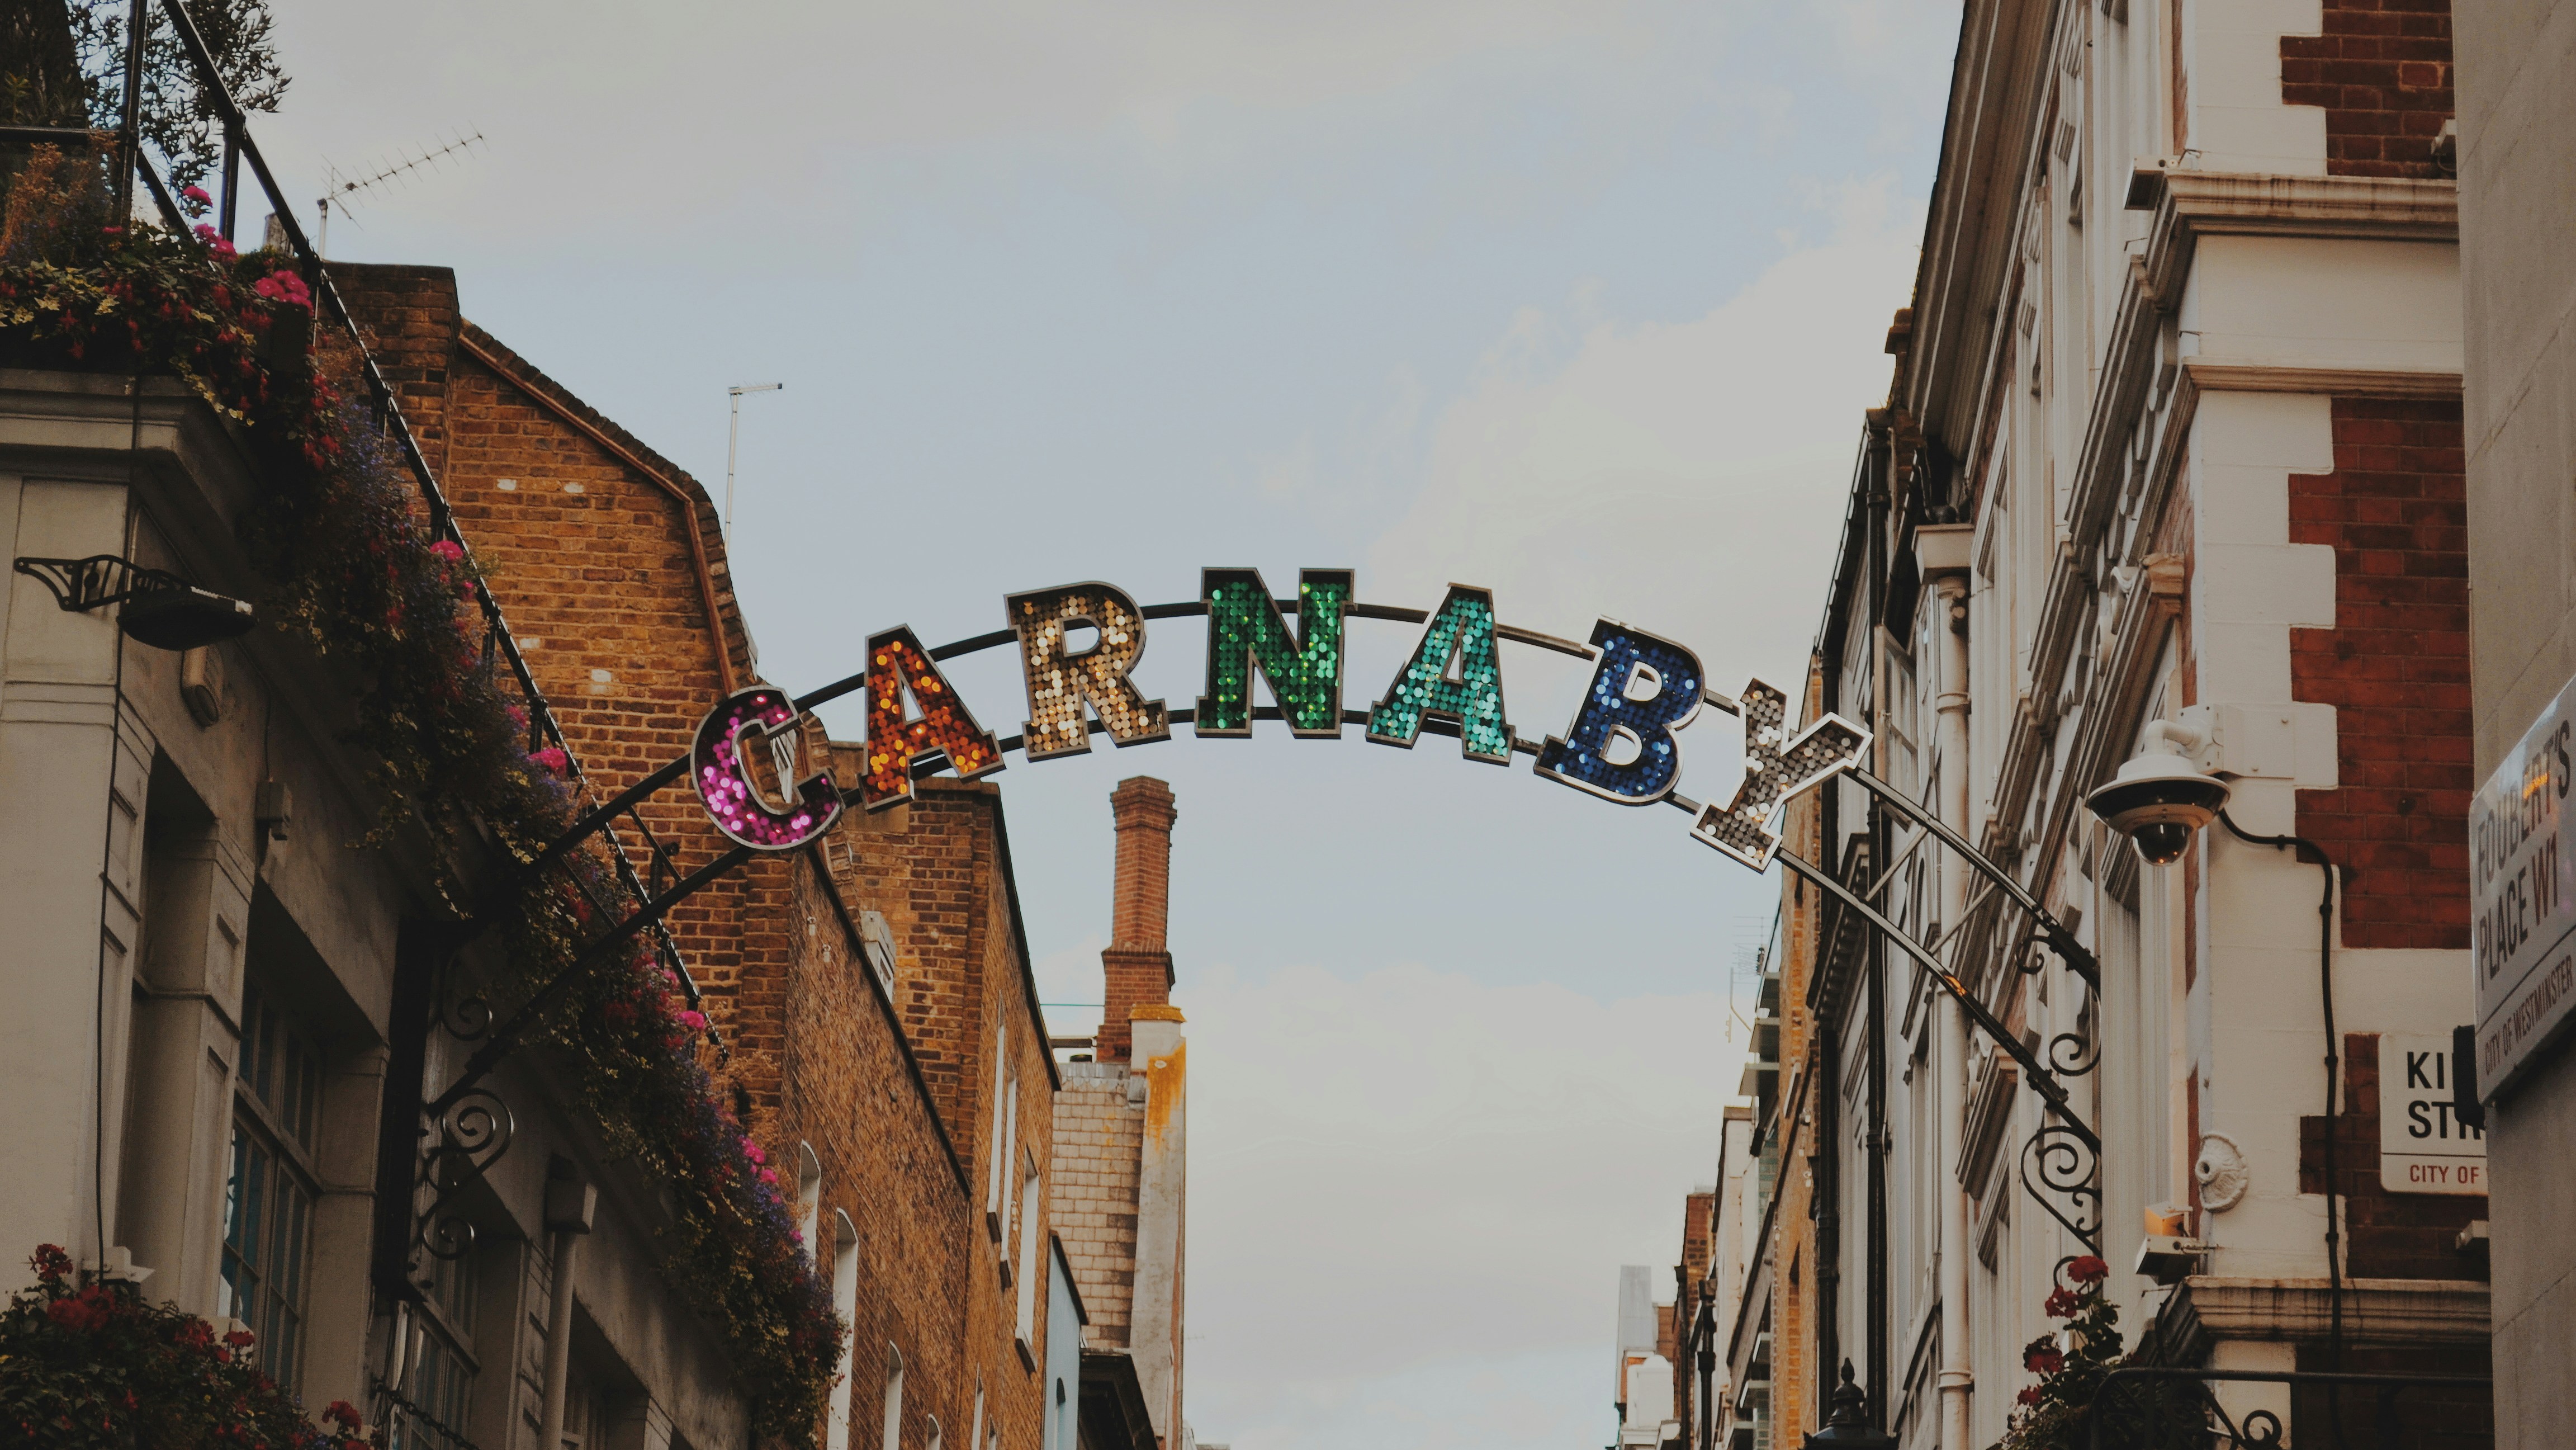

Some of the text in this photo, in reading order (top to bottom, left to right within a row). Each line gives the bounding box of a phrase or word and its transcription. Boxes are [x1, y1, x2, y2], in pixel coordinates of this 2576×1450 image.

[690, 566, 1874, 874] CARNABY
[2478, 719, 2570, 897] FOUBERT'S
[2479, 830, 2558, 992] PLACE W1
[2407, 1051, 2455, 1089] KI
[2485, 954, 2573, 1076] CITY OF WESTMINSTER
[2409, 1164, 2449, 1183] CITY
[2457, 1165, 2480, 1184] OF
